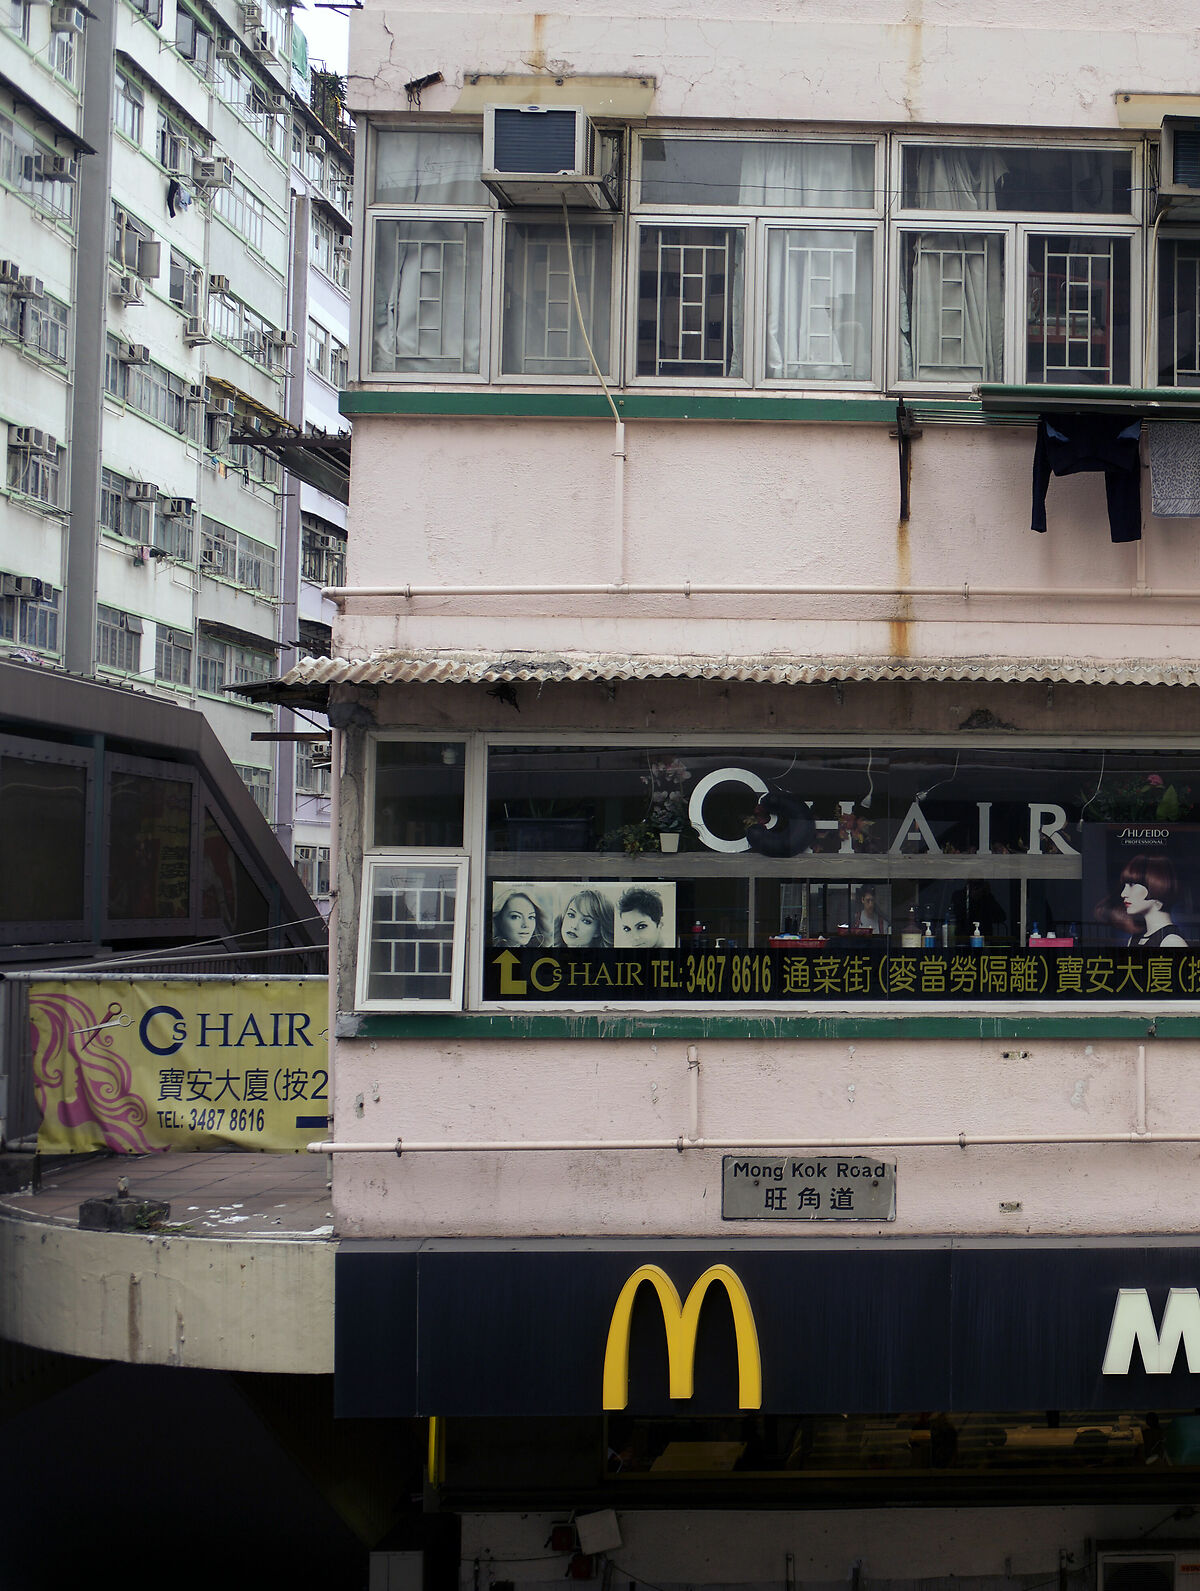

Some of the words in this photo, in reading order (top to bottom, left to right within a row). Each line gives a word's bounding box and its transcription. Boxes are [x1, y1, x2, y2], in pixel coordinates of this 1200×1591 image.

[1116, 828, 1170, 838] SHISEIDO
[651, 960, 683, 988] TEL:
[686, 955, 726, 993] 3487
[731, 955, 771, 993] 8616
[157, 1110, 184, 1129] TEL:
[188, 1108, 226, 1132] 3487
[229, 1108, 265, 1132] 8616
[733, 1162, 784, 1181] Mong
[791, 1162, 828, 1178] Kok
[836, 1162, 886, 1178] Road
[764, 1187, 854, 1211] 旺角道
